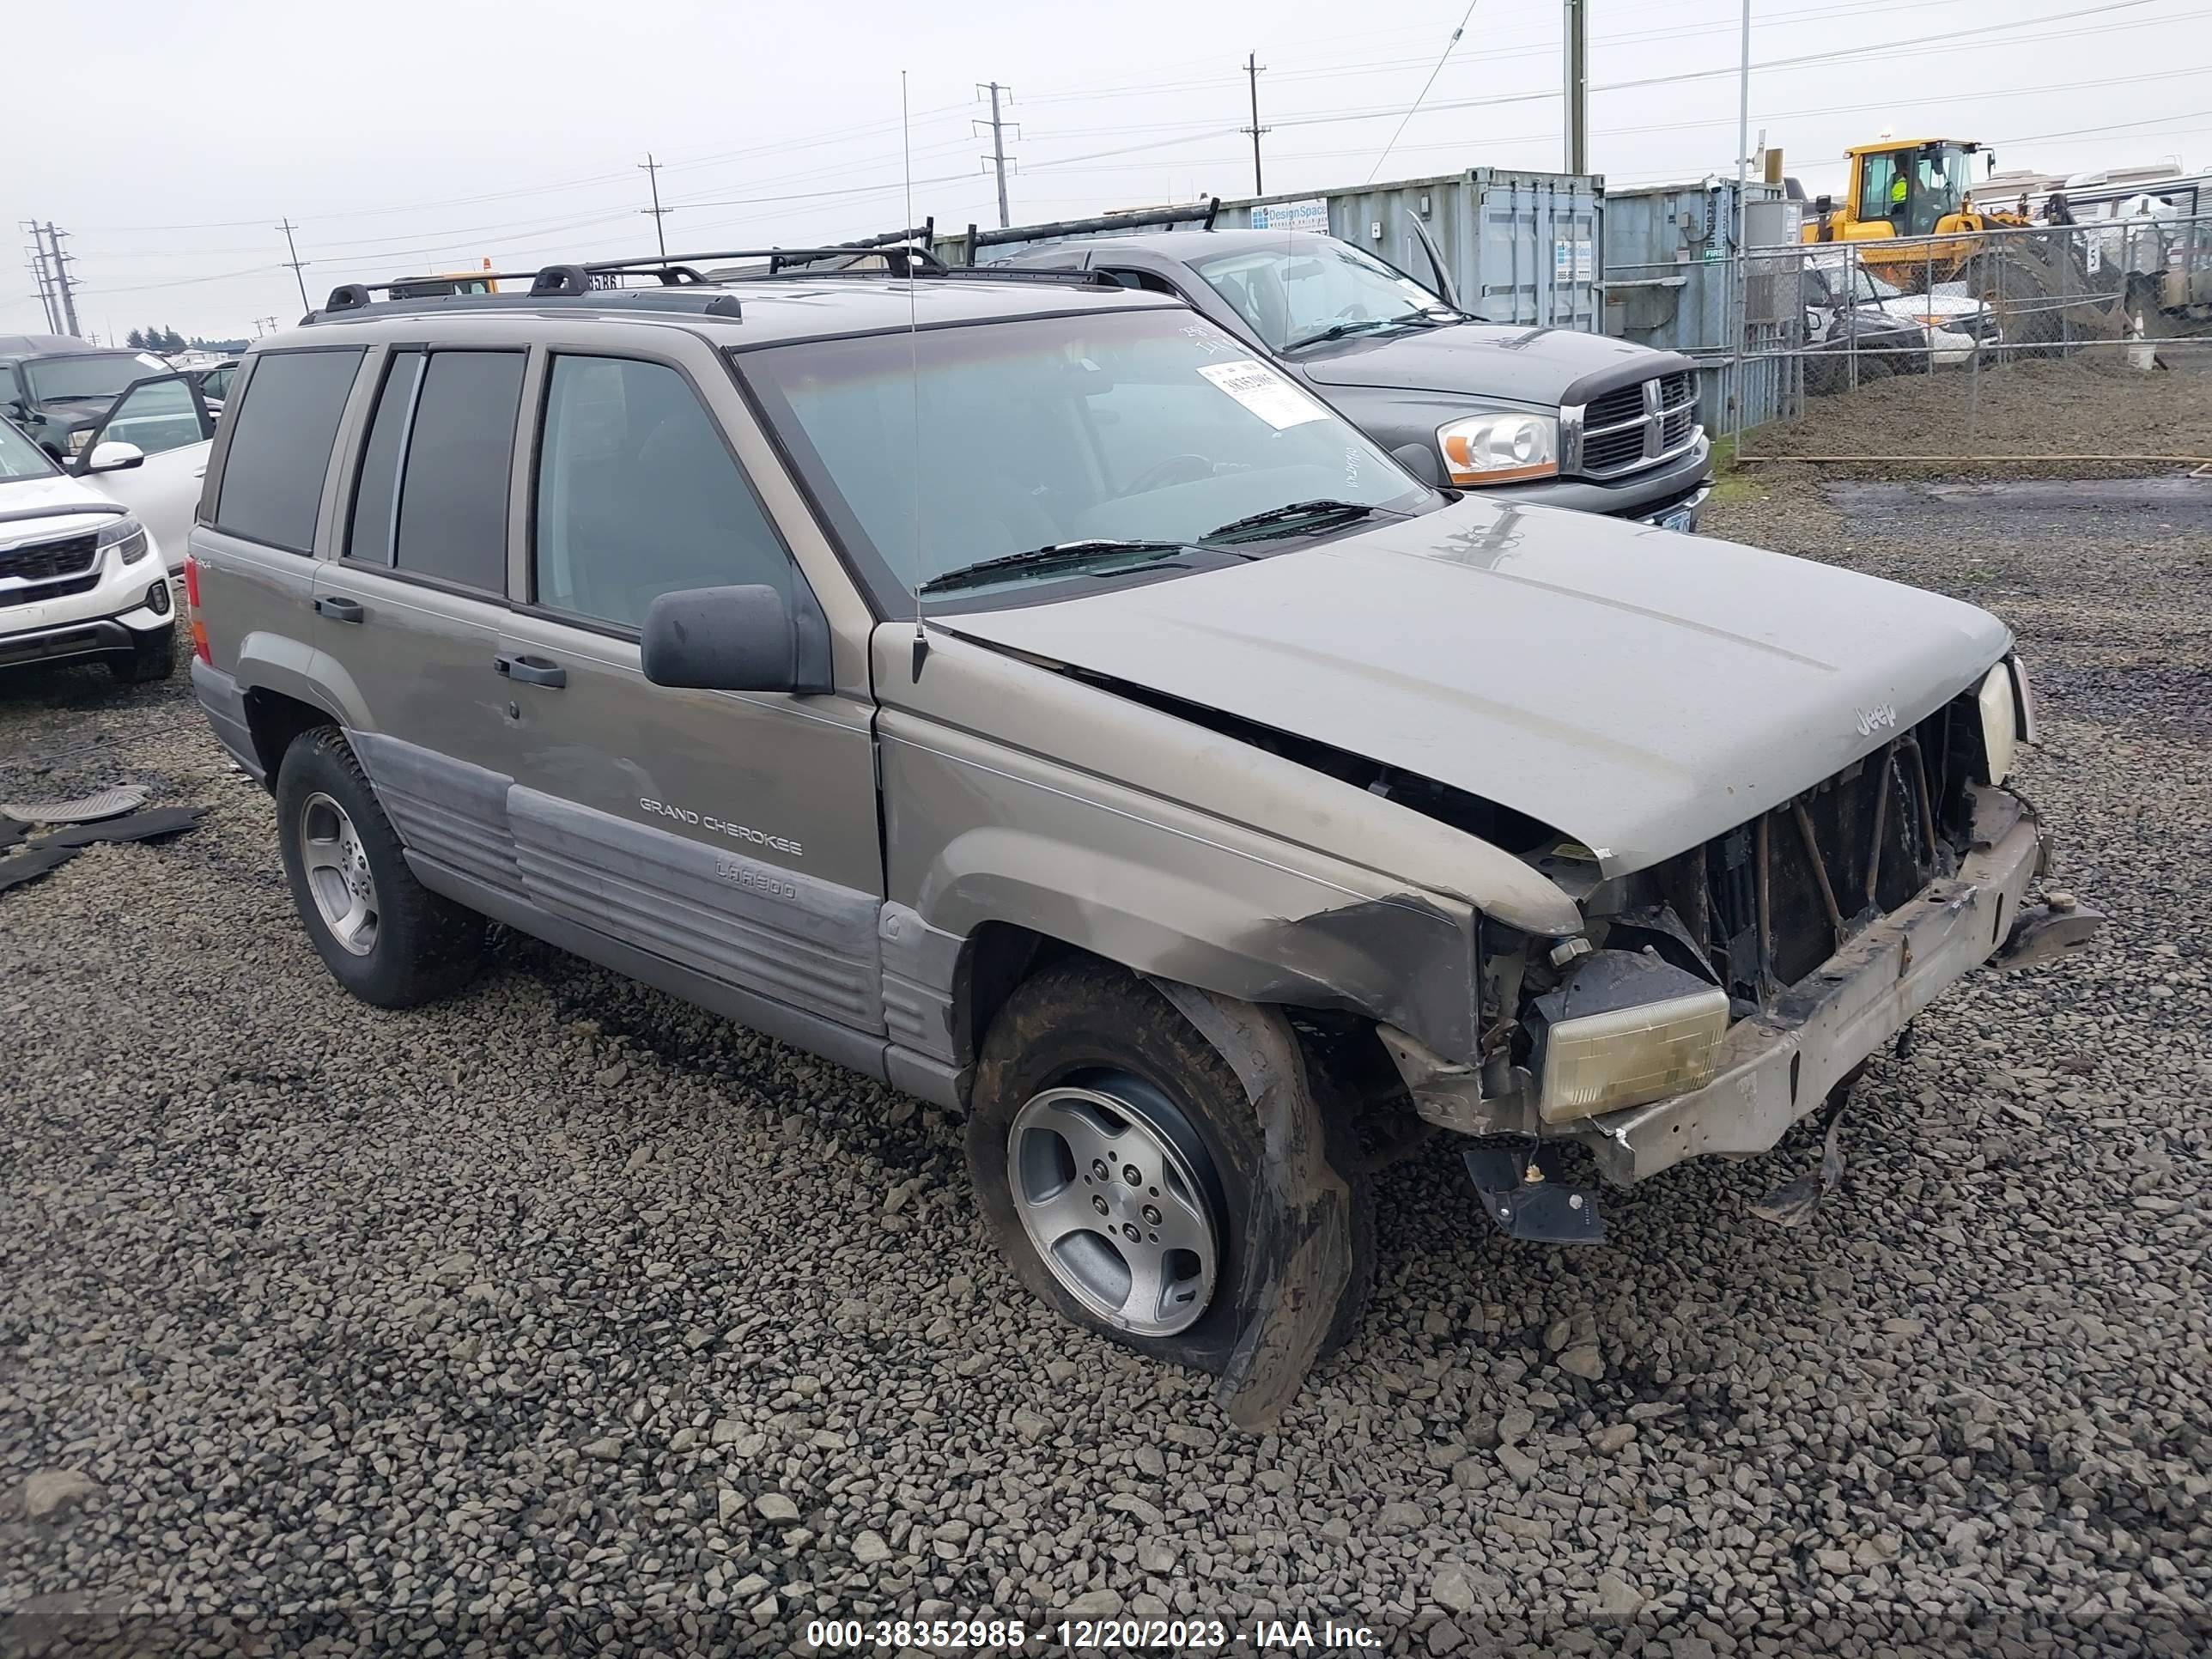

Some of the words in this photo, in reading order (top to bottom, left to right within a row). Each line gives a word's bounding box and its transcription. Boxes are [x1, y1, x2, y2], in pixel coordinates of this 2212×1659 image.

[1269, 204, 1328, 221] DesignSpace
[1855, 702, 1896, 736] Jeep
[639, 797, 699, 825] GRAND
[703, 816, 804, 857] CHEROKEE
[715, 860, 795, 899] LAREDO
